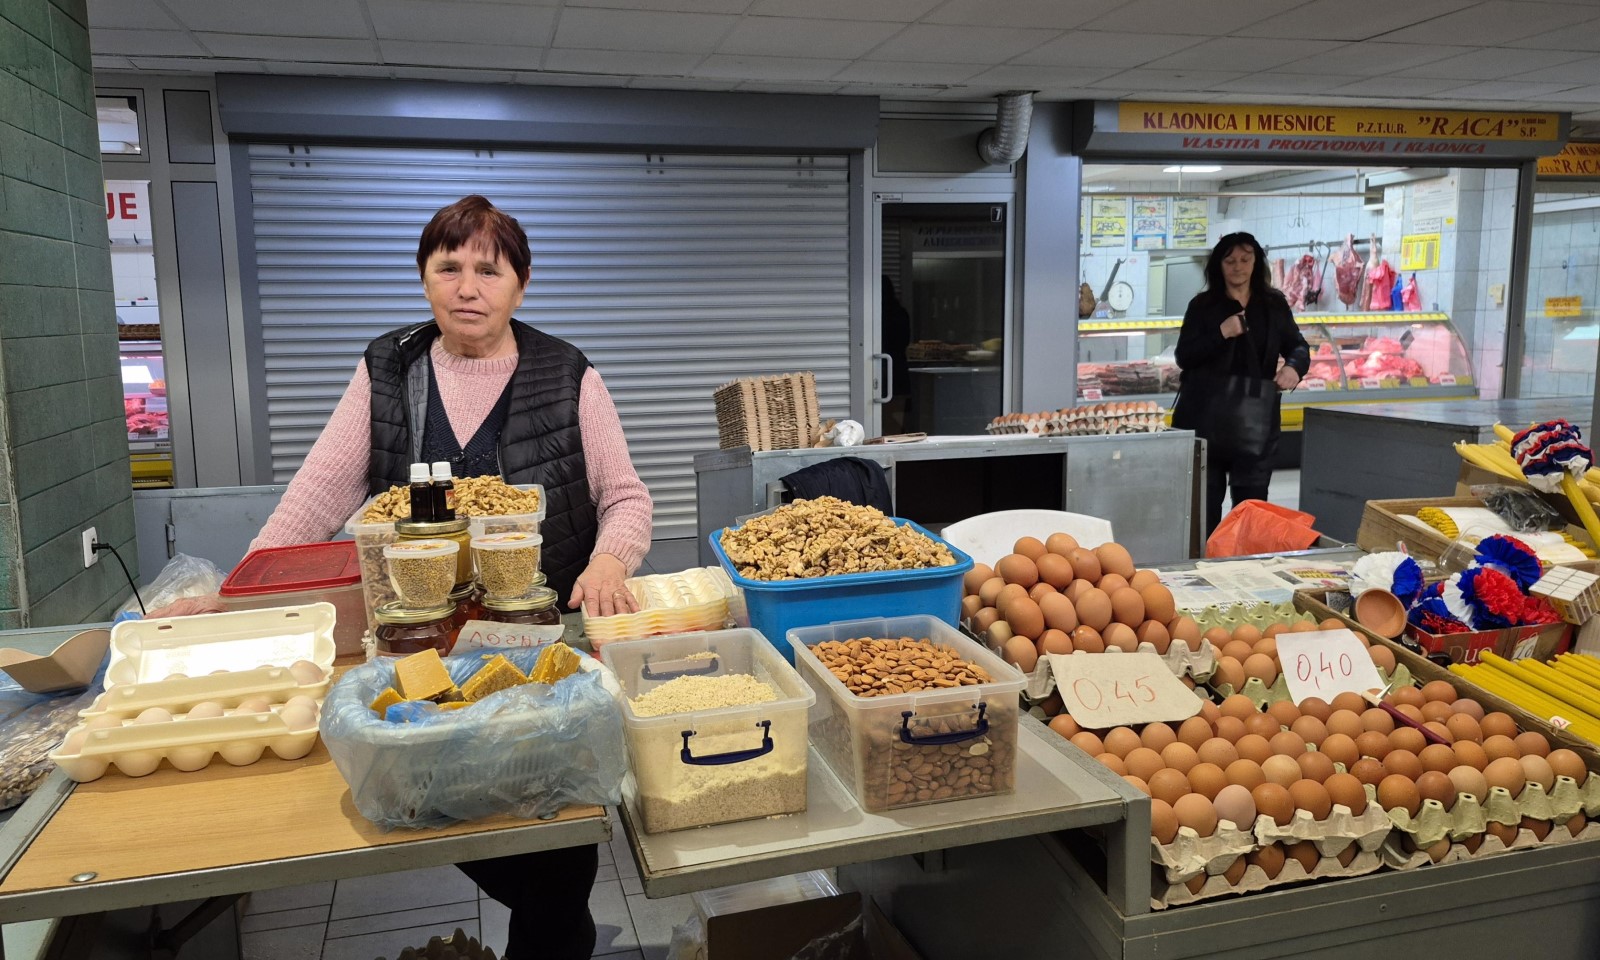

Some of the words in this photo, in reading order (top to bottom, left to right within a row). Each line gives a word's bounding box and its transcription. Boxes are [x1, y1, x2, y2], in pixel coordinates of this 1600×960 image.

[1143, 112, 1238, 131] KLAONICA
[1245, 114, 1250, 131] I
[1258, 114, 1336, 132] MESNICE
[1356, 122, 1407, 134] P.Z.T.U.R.
[1520, 127, 1537, 138] S.P.
[1182, 137, 1260, 149] VLASTITA
[1267, 139, 1385, 153] PROIZVODNJA
[1392, 142, 1401, 152] I
[1404, 142, 1487, 154] KLAONICA
[1296, 651, 1353, 690] 0,40
[1072, 674, 1157, 713] 0,45
